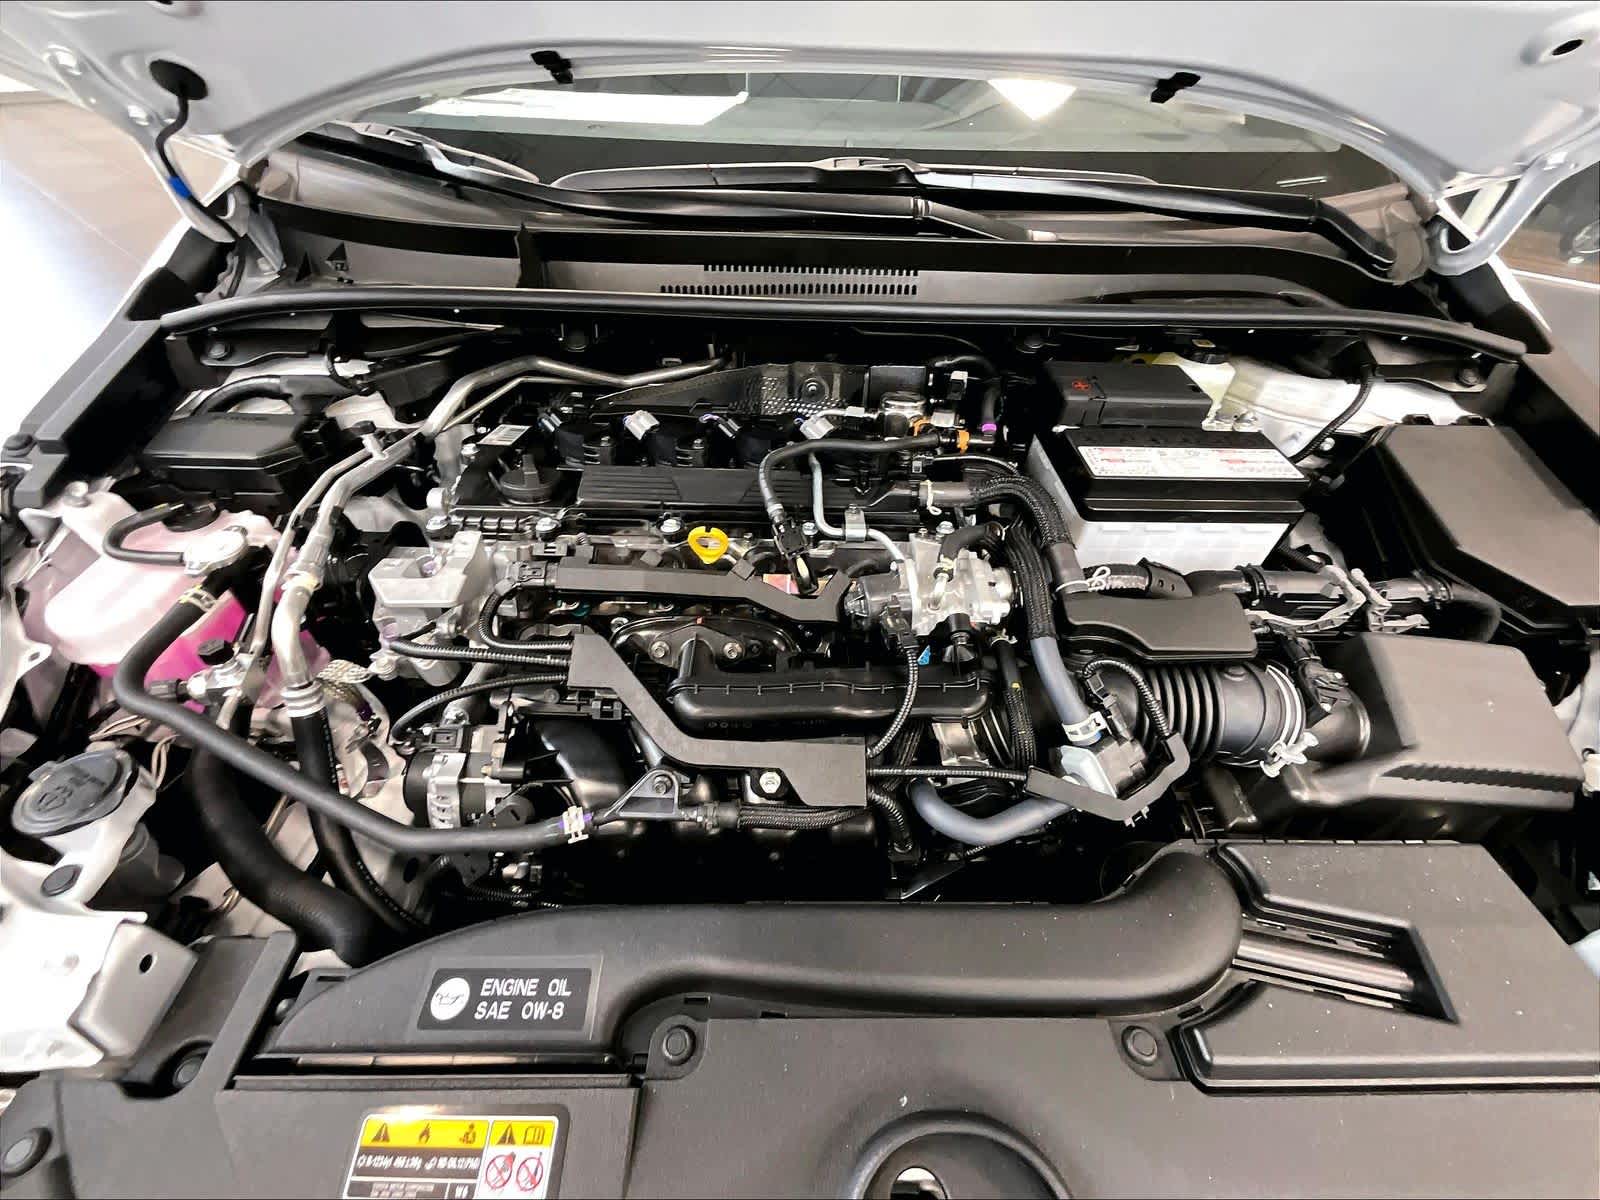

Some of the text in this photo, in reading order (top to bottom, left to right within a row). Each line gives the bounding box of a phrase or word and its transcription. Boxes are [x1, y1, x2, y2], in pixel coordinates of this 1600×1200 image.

[480, 978, 572, 997] ENGINE OIL
[474, 1001, 565, 1020] SAE 0W-8
